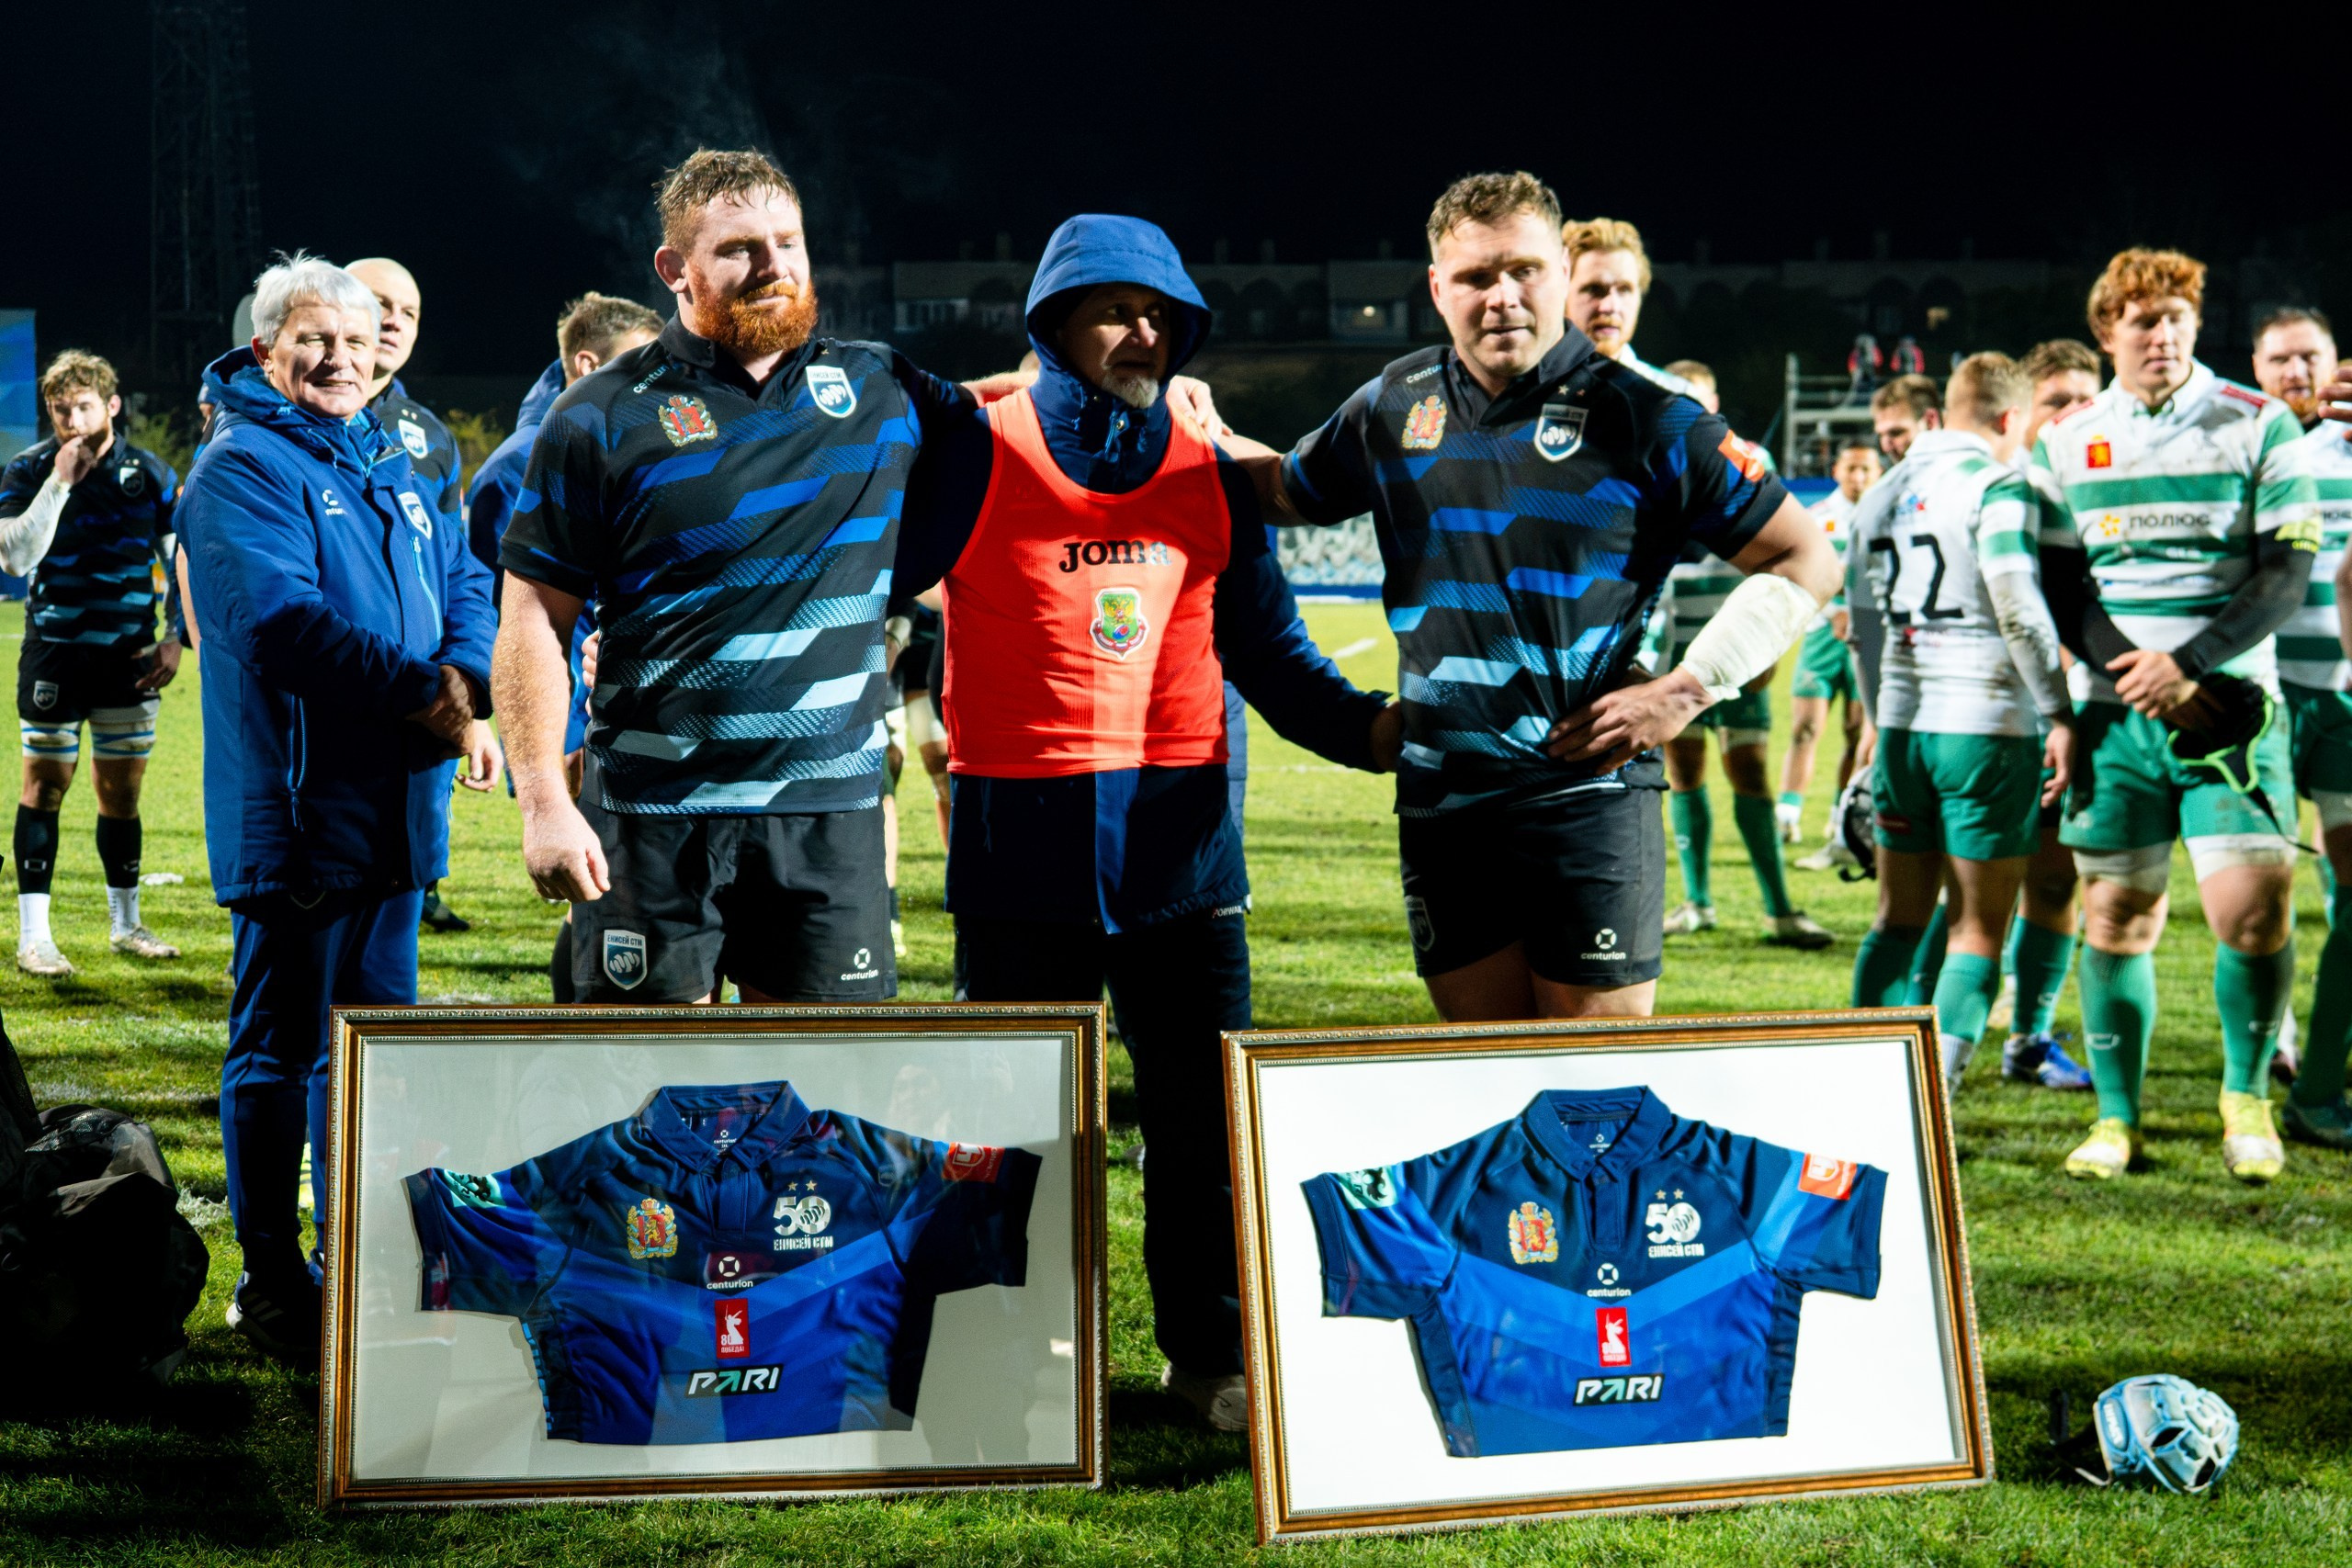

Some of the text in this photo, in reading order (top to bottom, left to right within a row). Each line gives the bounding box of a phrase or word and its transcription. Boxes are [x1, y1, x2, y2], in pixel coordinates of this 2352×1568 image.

[632, 364, 670, 394] centur
[1869, 533, 1964, 624] 22
[607, 933, 643, 947] ЕНИСЕЙ СТМ
[1580, 951, 1627, 961] centurion
[840, 968, 879, 981] centurion
[773, 1195, 831, 1236] 50
[1645, 1201, 1702, 1245] 50
[774, 1235, 834, 1251] ЕНИСЕЙ СТМ
[1647, 1241, 1684, 1259] ЕНИСЕЙ
[706, 1280, 753, 1290] centurion
[1587, 1288, 1632, 1298] centurion
[688, 1367, 780, 1395] PARI
[1575, 1375, 1662, 1404] PARI
